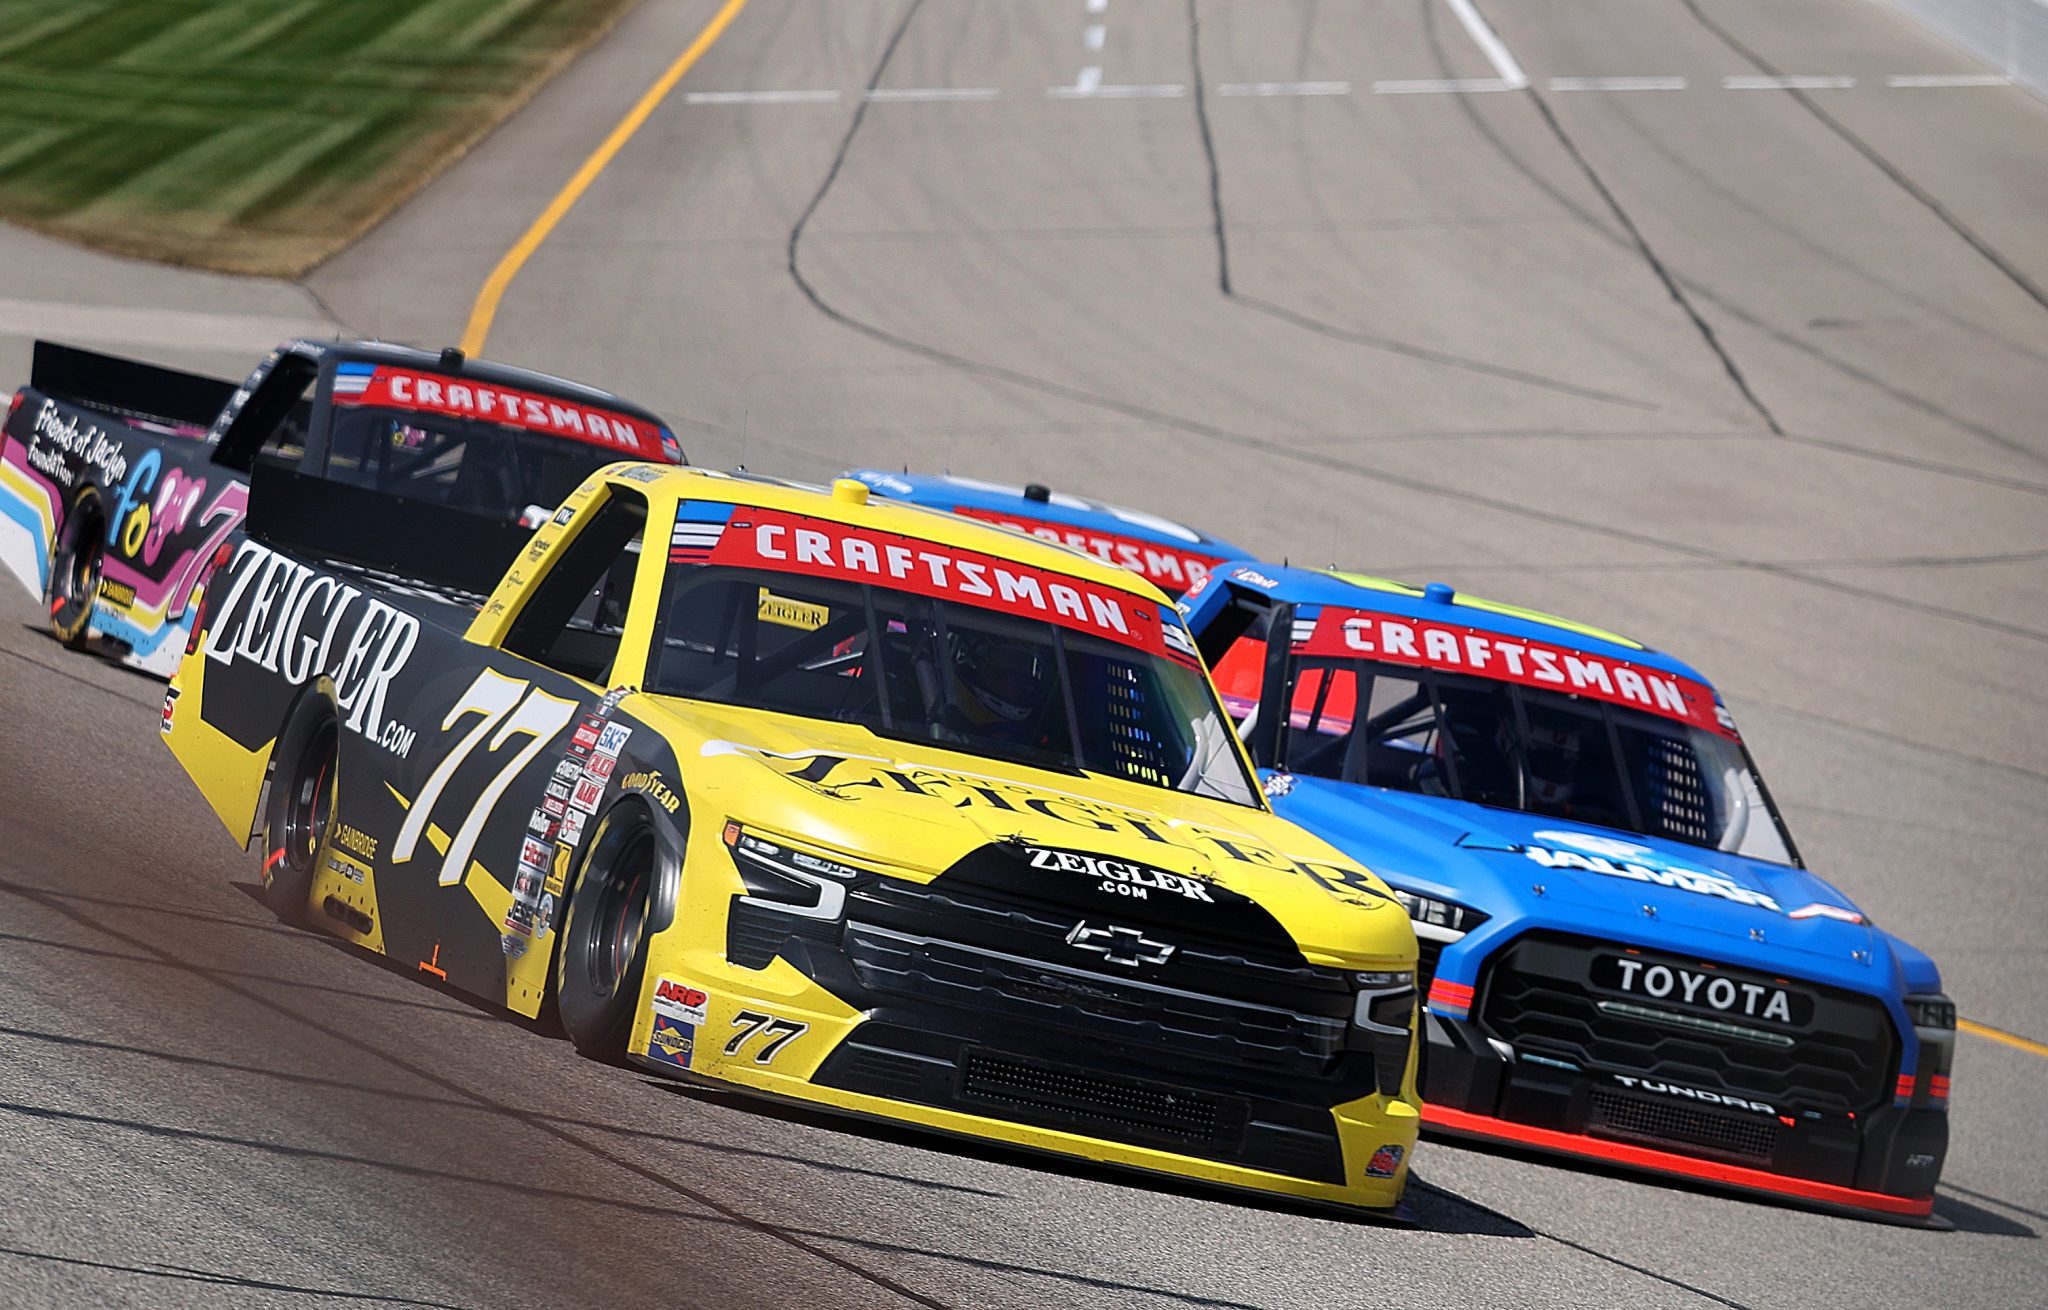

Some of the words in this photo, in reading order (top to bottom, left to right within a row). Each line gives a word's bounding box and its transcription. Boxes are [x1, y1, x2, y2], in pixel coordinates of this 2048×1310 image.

[36, 399, 79, 452] Friends
[74, 425, 97, 458] of
[389, 375, 640, 450] CRAFTSMAN
[27, 434, 75, 488] Foundation
[755, 525, 1130, 635] CRAFTSMAN
[760, 600, 822, 626] ZEIGLER
[204, 539, 421, 743] ZEIGLER
[376, 719, 417, 759] .COM
[1344, 617, 1689, 717] CRAFTSMAN
[599, 725, 628, 751] SKF
[390, 666, 580, 887] 77
[621, 769, 682, 815] GOODYEAR
[759, 750, 1404, 906] ZEIGLER
[1024, 847, 1216, 903] ZEIGLER
[1097, 880, 1148, 900] .COM
[655, 979, 707, 1008] ARP
[1616, 958, 1792, 1023] TOYOTA
[652, 1028, 693, 1054] SUNOCO
[722, 1007, 811, 1065] 77
[1613, 1074, 1776, 1115] TUNDRA
